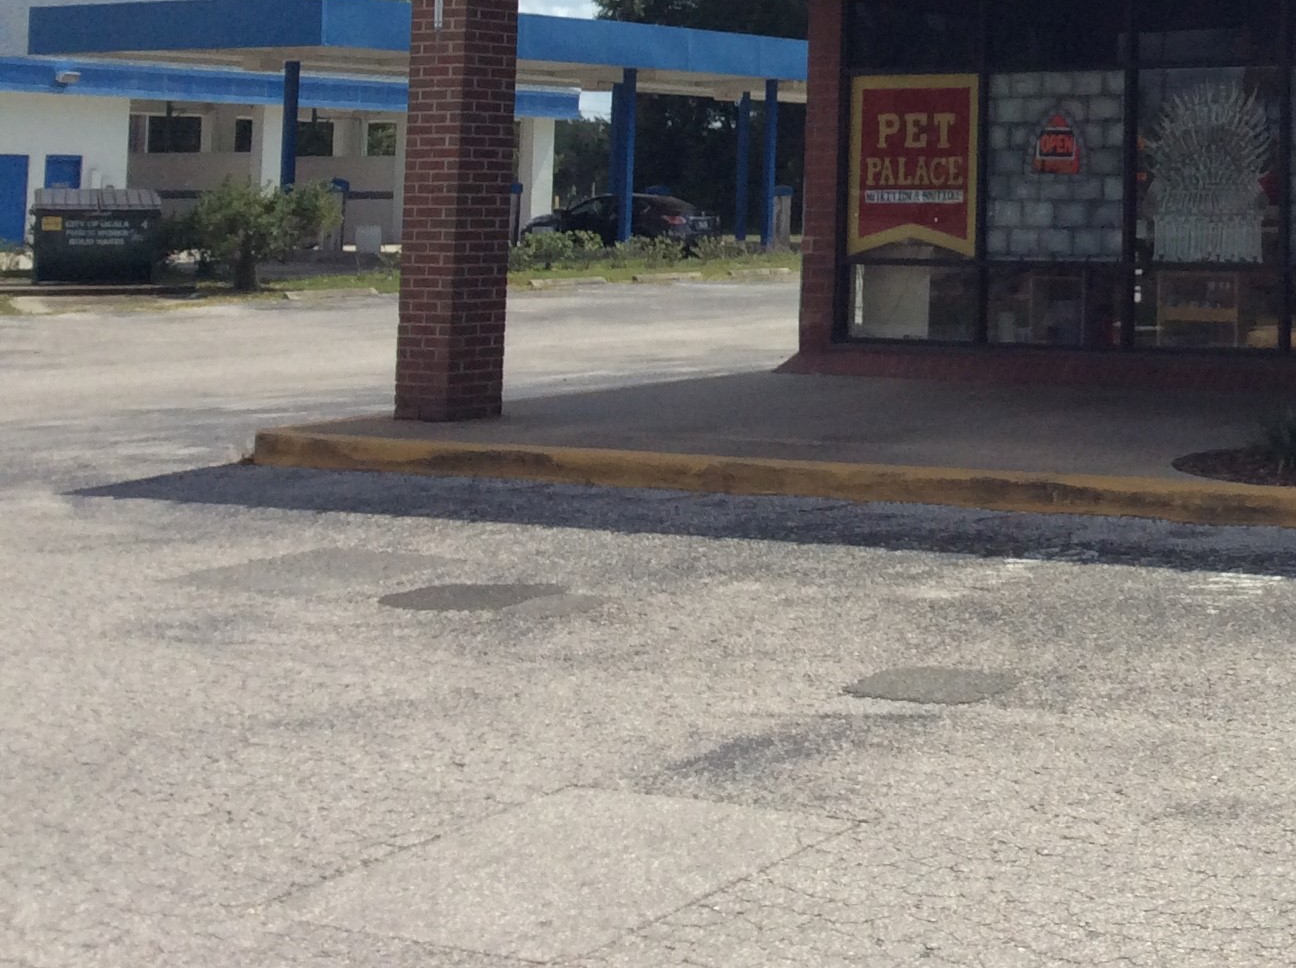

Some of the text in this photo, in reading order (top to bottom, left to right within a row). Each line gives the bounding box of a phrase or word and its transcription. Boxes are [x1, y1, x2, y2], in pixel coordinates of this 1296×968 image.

[877, 112, 956, 149] PET
[1039, 134, 1074, 153] OPEN
[865, 155, 964, 186] PALACE
